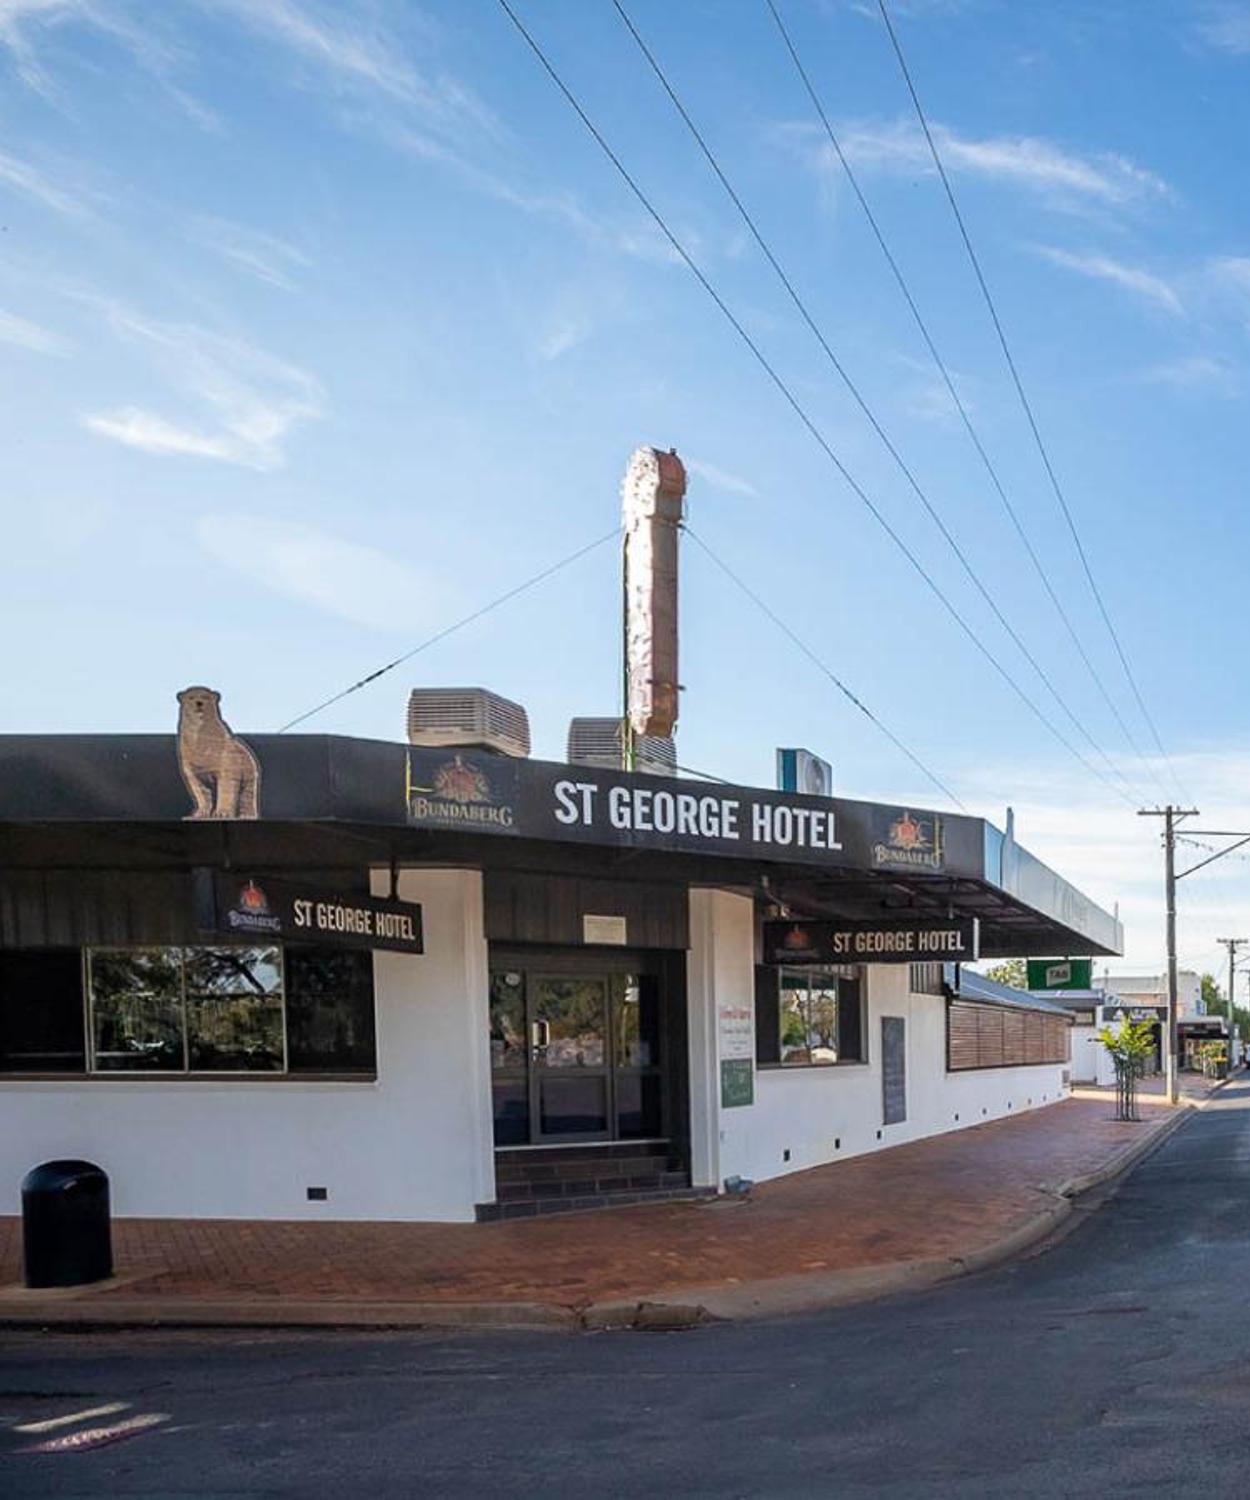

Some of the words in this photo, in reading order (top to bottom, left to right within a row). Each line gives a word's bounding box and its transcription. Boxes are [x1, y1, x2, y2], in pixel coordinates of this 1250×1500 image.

[411, 797, 513, 827] BUNDABERG
[554, 780, 598, 825] ST
[608, 786, 740, 840] GEORGE
[751, 803, 843, 850] HOTEL
[293, 899, 314, 927] ST
[316, 905, 373, 935] GEORGE
[375, 913, 416, 941] HOTEL
[833, 932, 850, 953] ST
[854, 931, 914, 952] GEORGE
[918, 930, 965, 951] HOTEL
